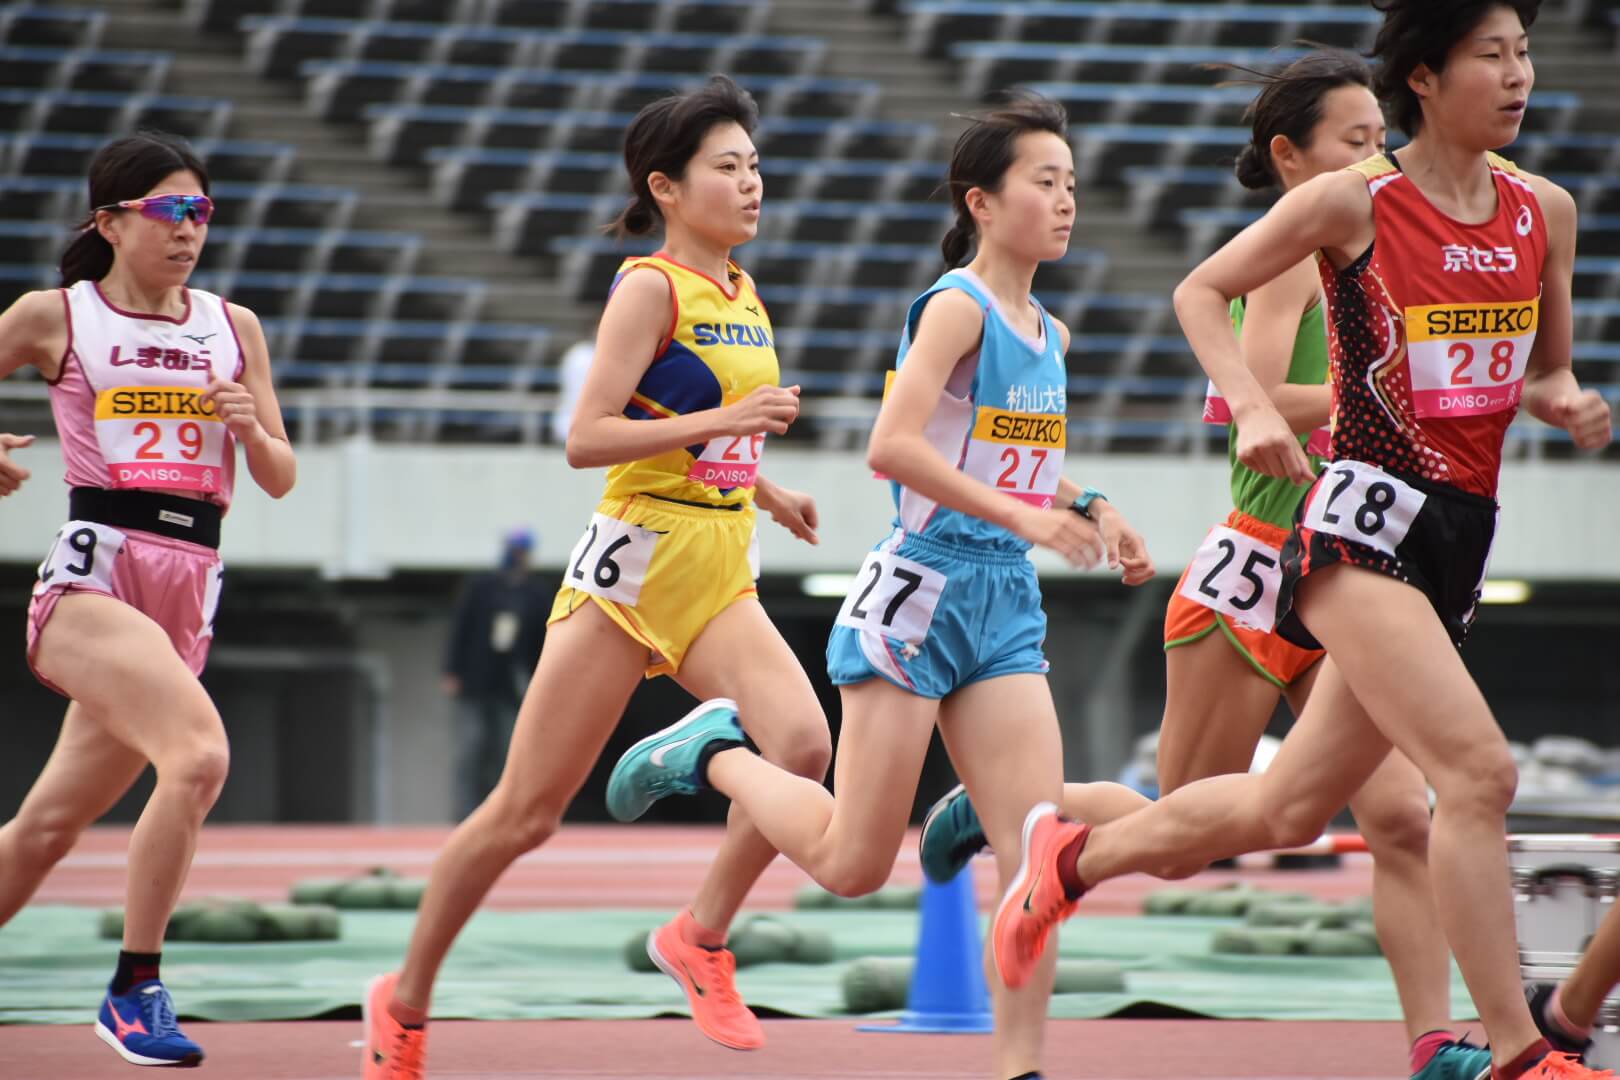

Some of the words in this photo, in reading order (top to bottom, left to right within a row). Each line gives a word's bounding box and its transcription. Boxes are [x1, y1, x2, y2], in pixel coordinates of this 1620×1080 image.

[1442, 244, 1517, 272] 京セラ
[1427, 306, 1533, 335] SEIKO
[110, 346, 212, 371] しまむら
[1447, 340, 1515, 385] 28
[1439, 394, 1489, 410] DAISO
[133, 421, 203, 461] 29
[991, 415, 1062, 443] SEIKO
[119, 469, 182, 482] DAISO
[704, 469, 749, 482] DAISO
[996, 447, 1048, 490] 27
[1322, 469, 1396, 536] 28
[572, 523, 631, 588] 26
[1198, 538, 1276, 611] 25
[849, 560, 923, 627] 27
